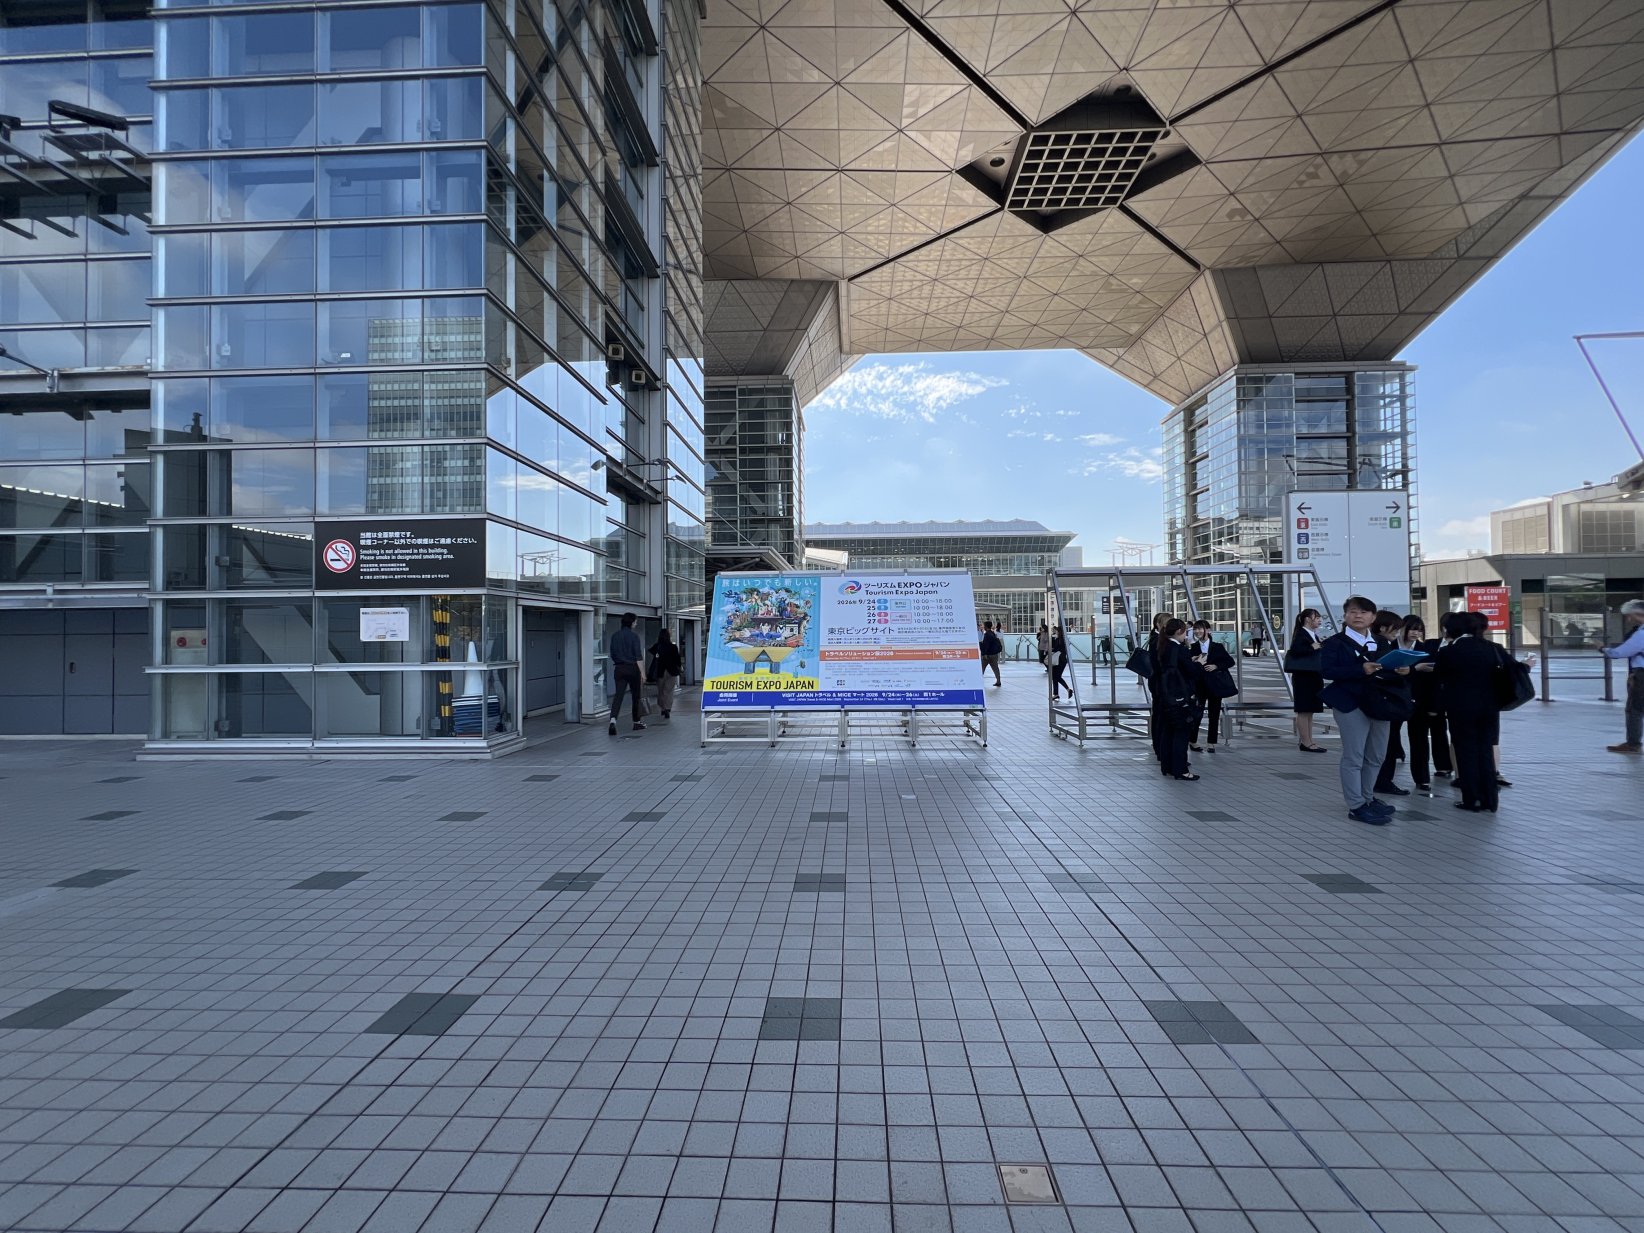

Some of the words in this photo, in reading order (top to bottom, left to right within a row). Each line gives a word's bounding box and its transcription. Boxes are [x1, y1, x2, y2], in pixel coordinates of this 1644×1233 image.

[722, 579, 818, 587] 旅はいつでも新しい。
[710, 681, 752, 690] TOURISM
[756, 681, 781, 690] EXPO
[783, 680, 814, 690] JAPAN
